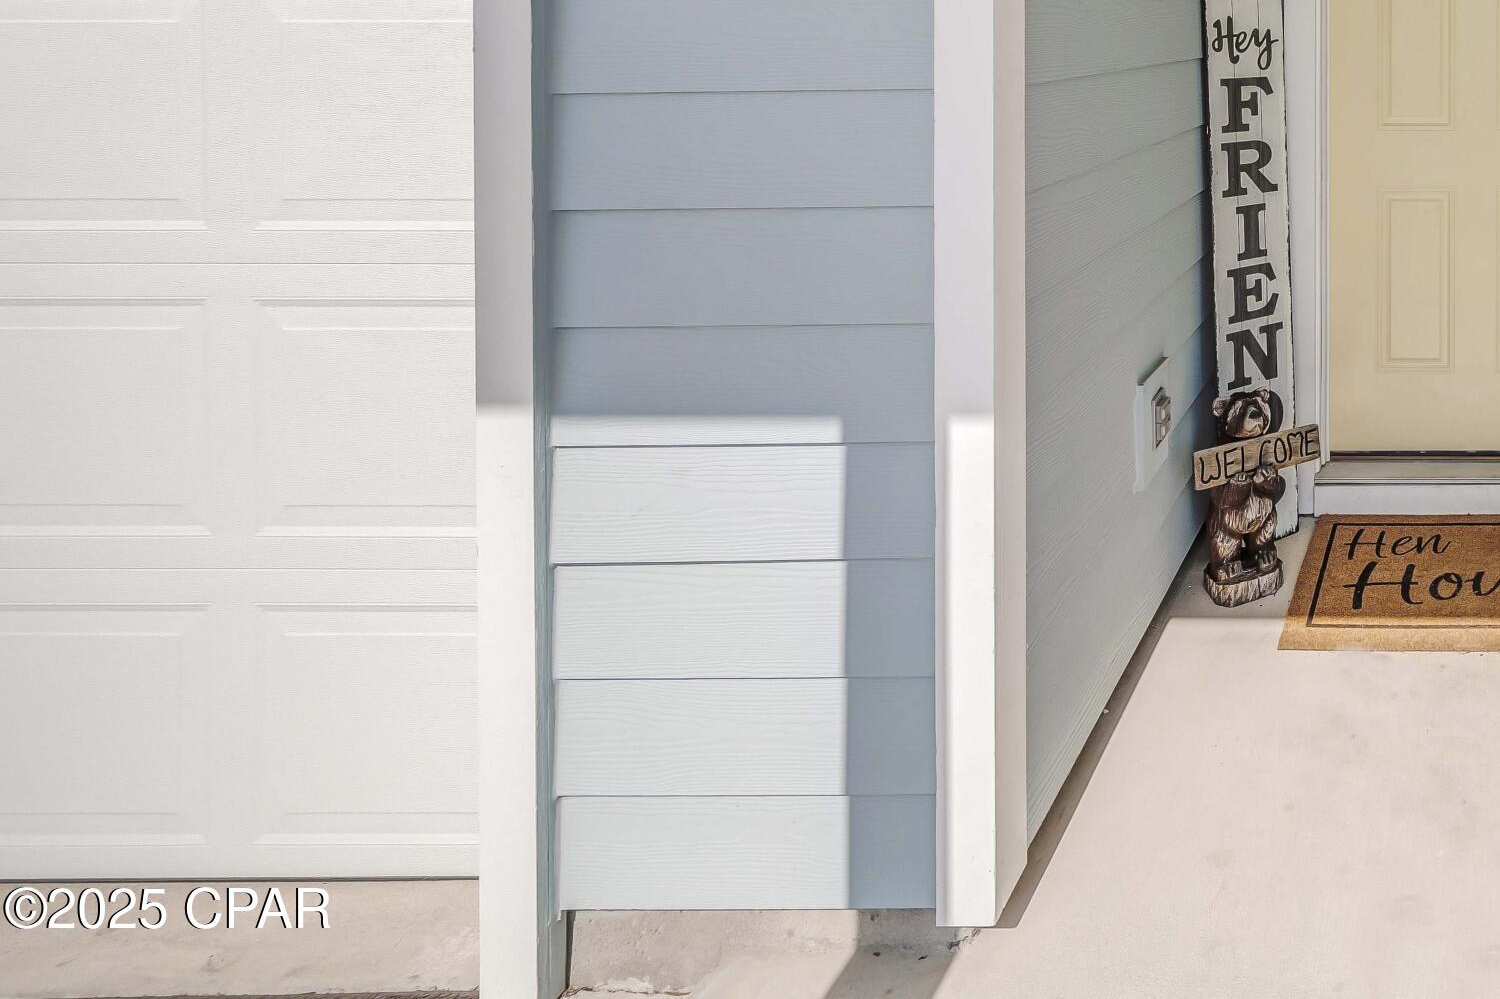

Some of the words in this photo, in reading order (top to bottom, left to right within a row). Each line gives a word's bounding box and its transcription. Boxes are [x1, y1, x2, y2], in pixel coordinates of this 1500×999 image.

[1211, 16, 1279, 67] Hey
[1219, 76, 1286, 504] FRIEN
[1199, 428, 1318, 484] WELCOME
[1344, 528, 1452, 561] Hen
